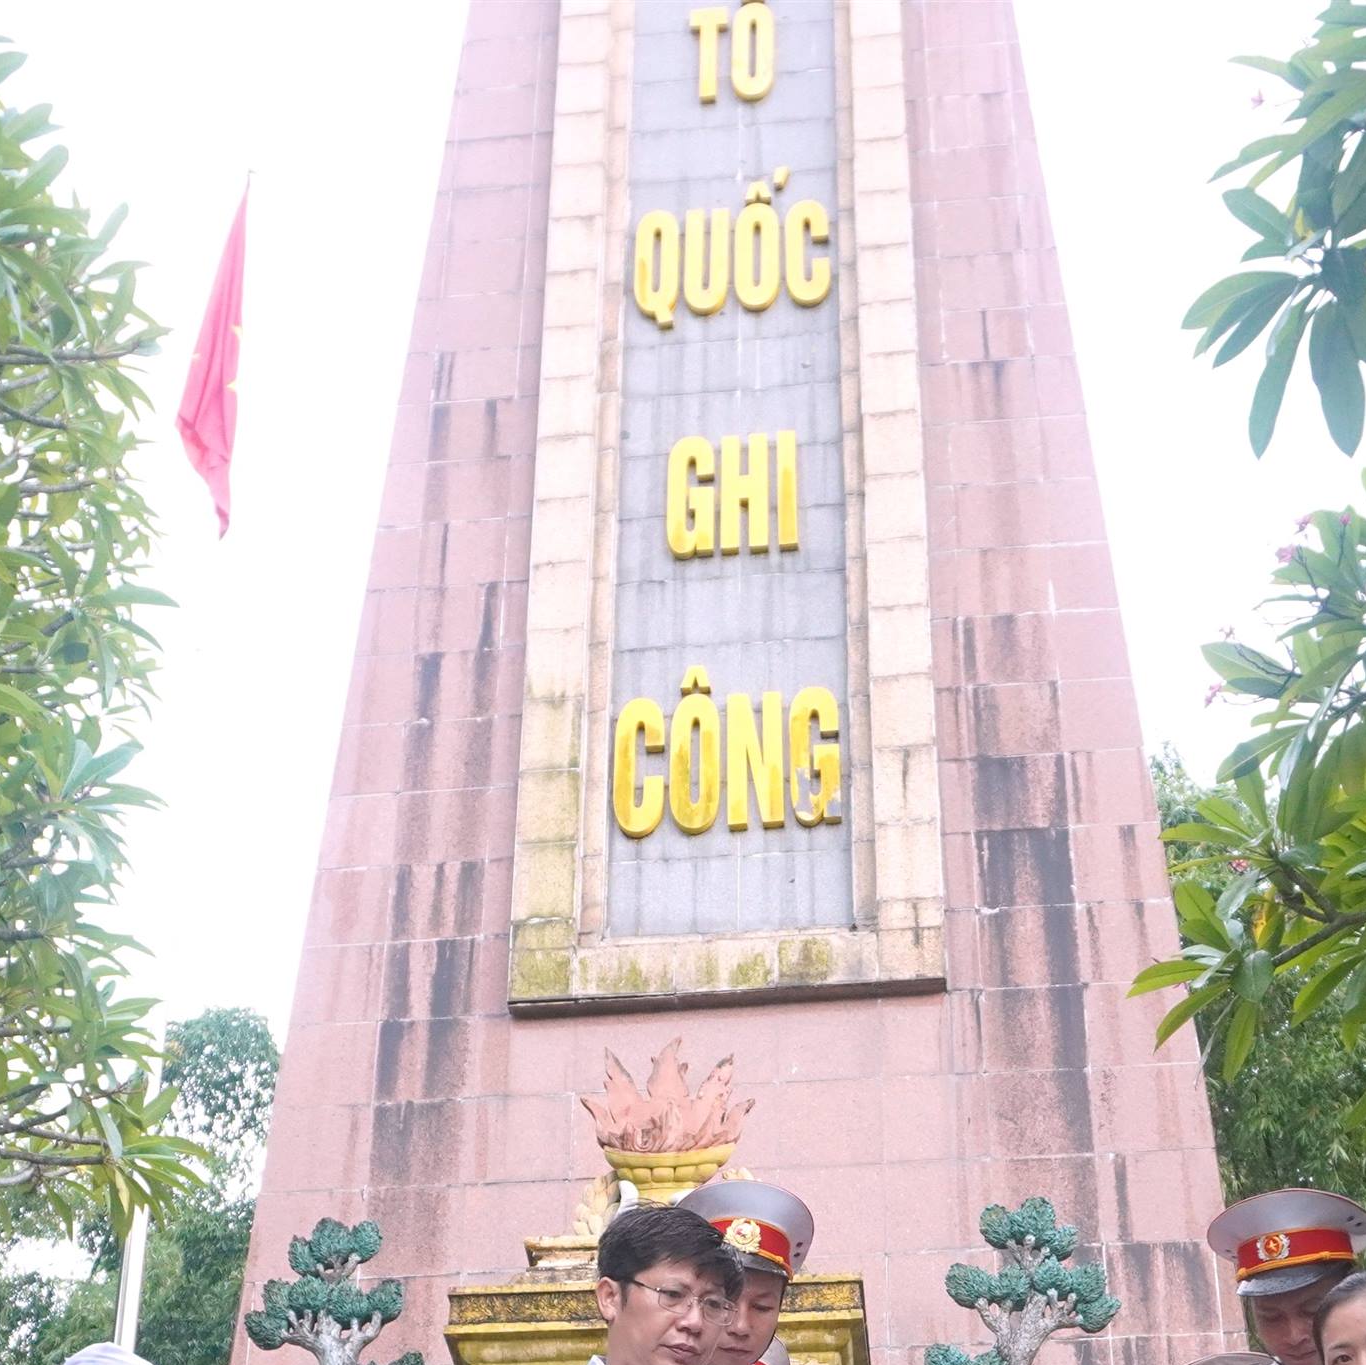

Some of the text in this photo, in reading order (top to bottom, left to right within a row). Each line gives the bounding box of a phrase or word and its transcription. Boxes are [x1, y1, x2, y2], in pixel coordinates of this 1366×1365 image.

[634, 166, 831, 330] QUỐC
[667, 430, 799, 560] GHI
[613, 665, 842, 838] CÔNG
